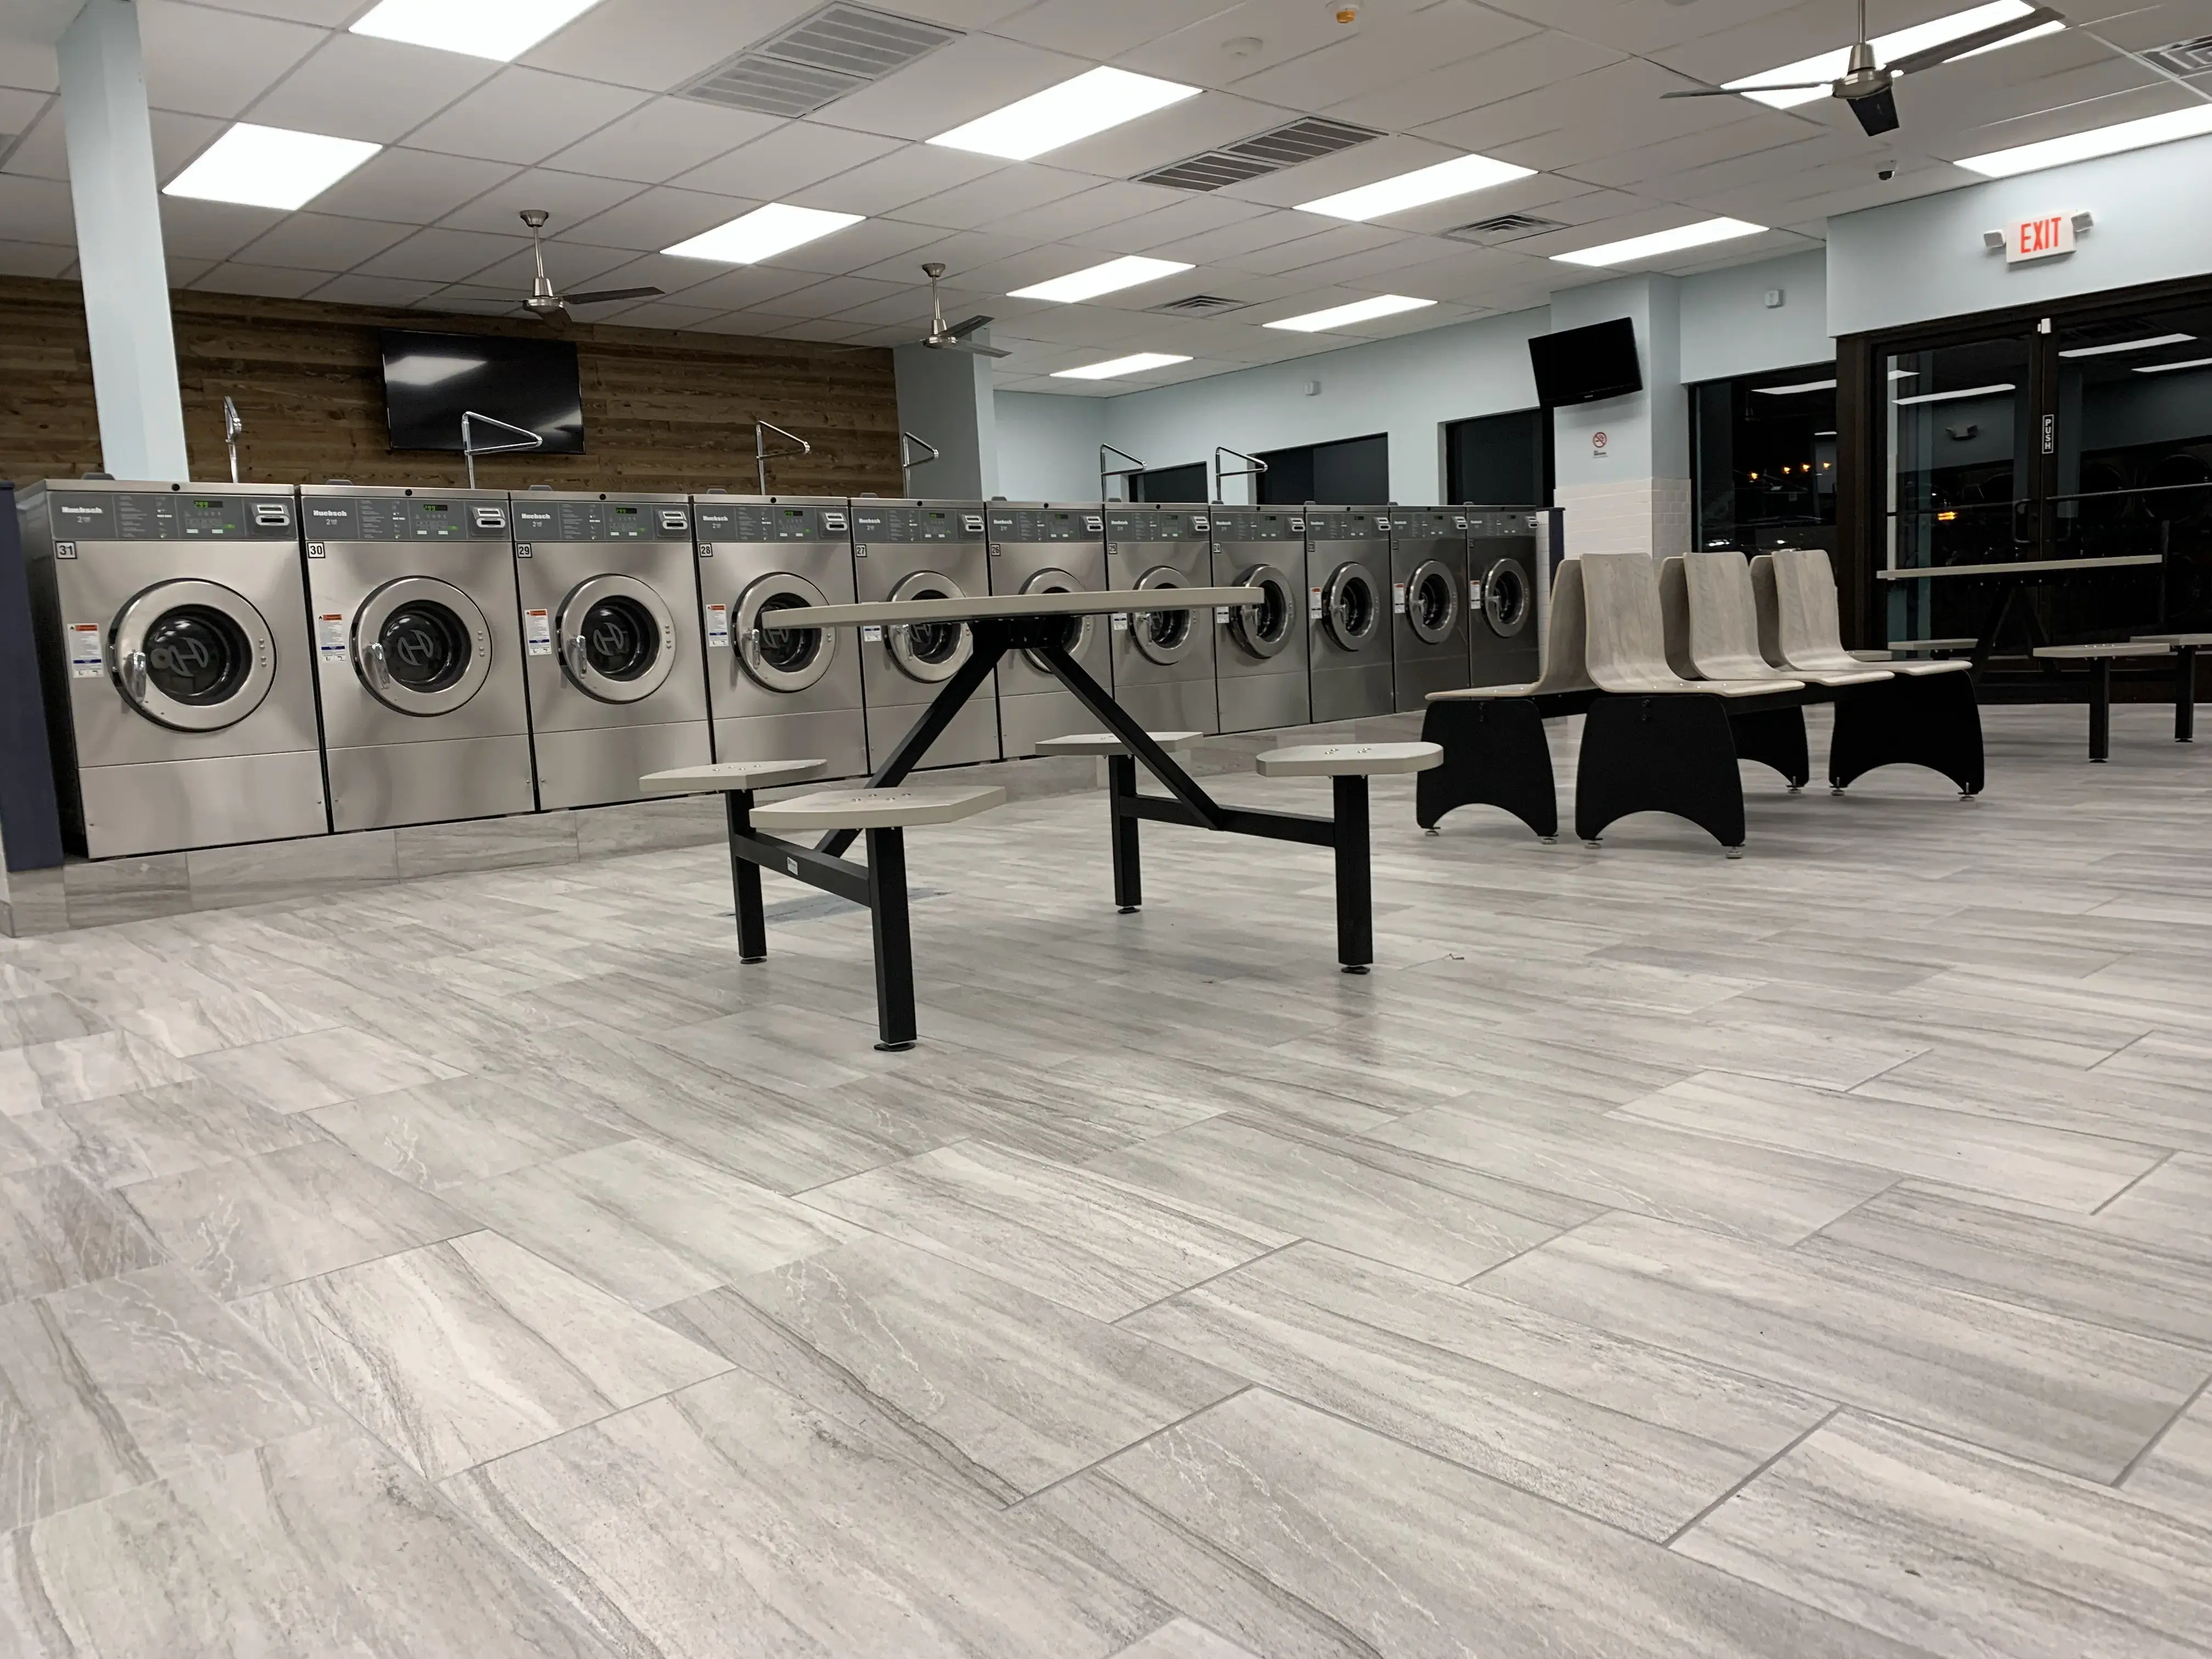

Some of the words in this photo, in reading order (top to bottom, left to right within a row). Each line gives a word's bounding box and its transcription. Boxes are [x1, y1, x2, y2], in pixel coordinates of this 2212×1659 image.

[2021, 217, 2062, 254] EXIT
[59, 545, 73, 555] 31
[309, 545, 323, 555] 30
[519, 546, 530, 555] 29
[701, 546, 711, 555] 28
[857, 546, 865, 555] 27
